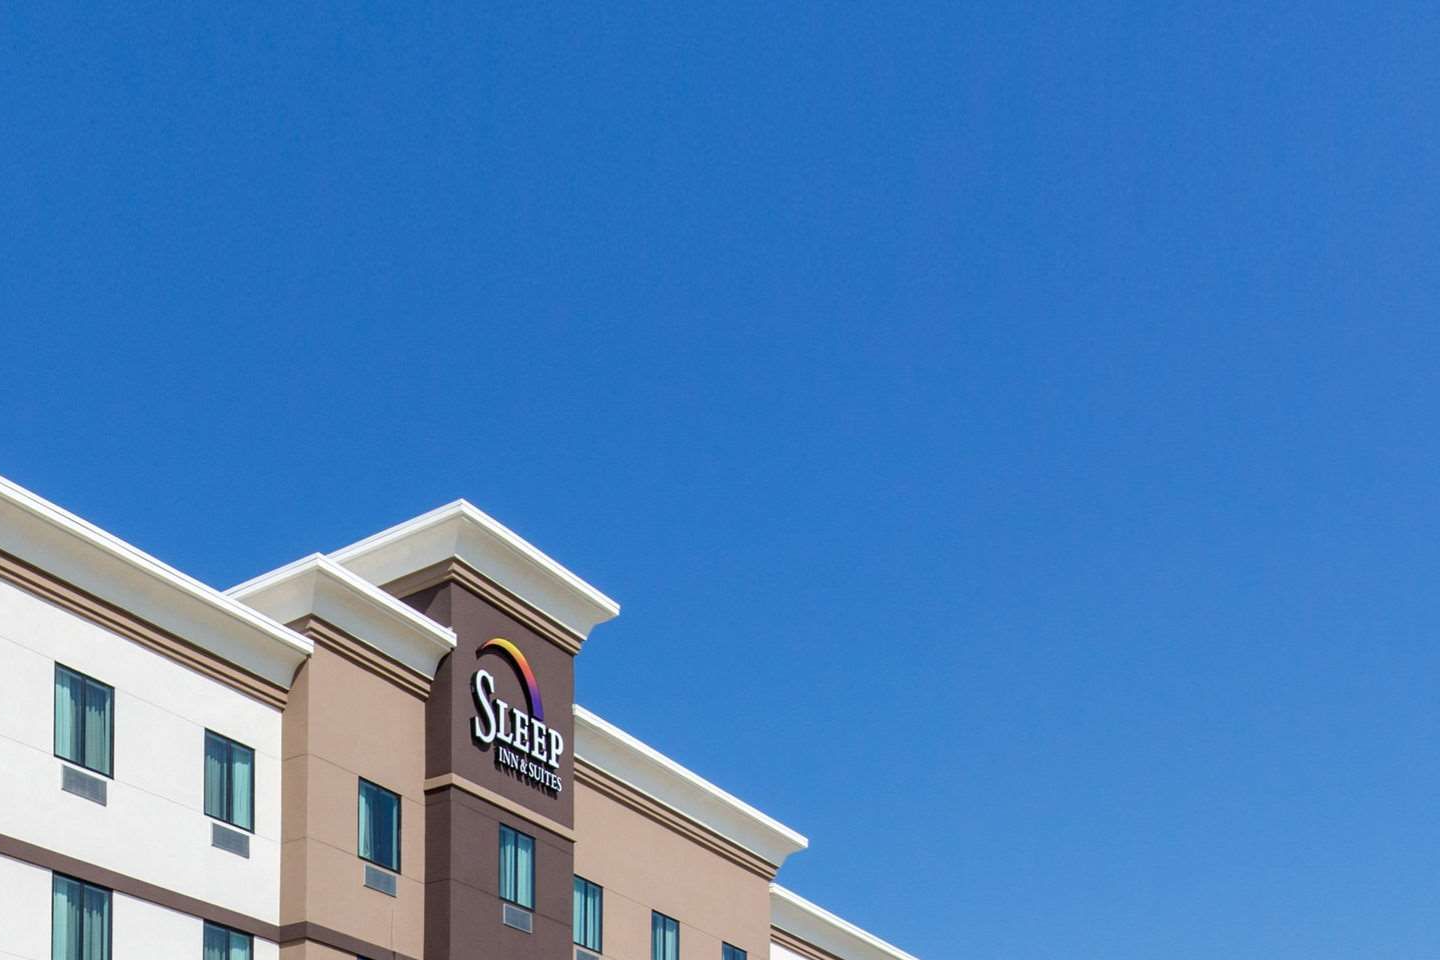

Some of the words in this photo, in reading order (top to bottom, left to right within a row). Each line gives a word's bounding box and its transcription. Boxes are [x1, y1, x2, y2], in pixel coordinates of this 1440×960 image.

[475, 669, 564, 769] SLEEP
[499, 746, 519, 770] INN
[520, 758, 528, 775] &
[528, 762, 563, 792] SUITES
